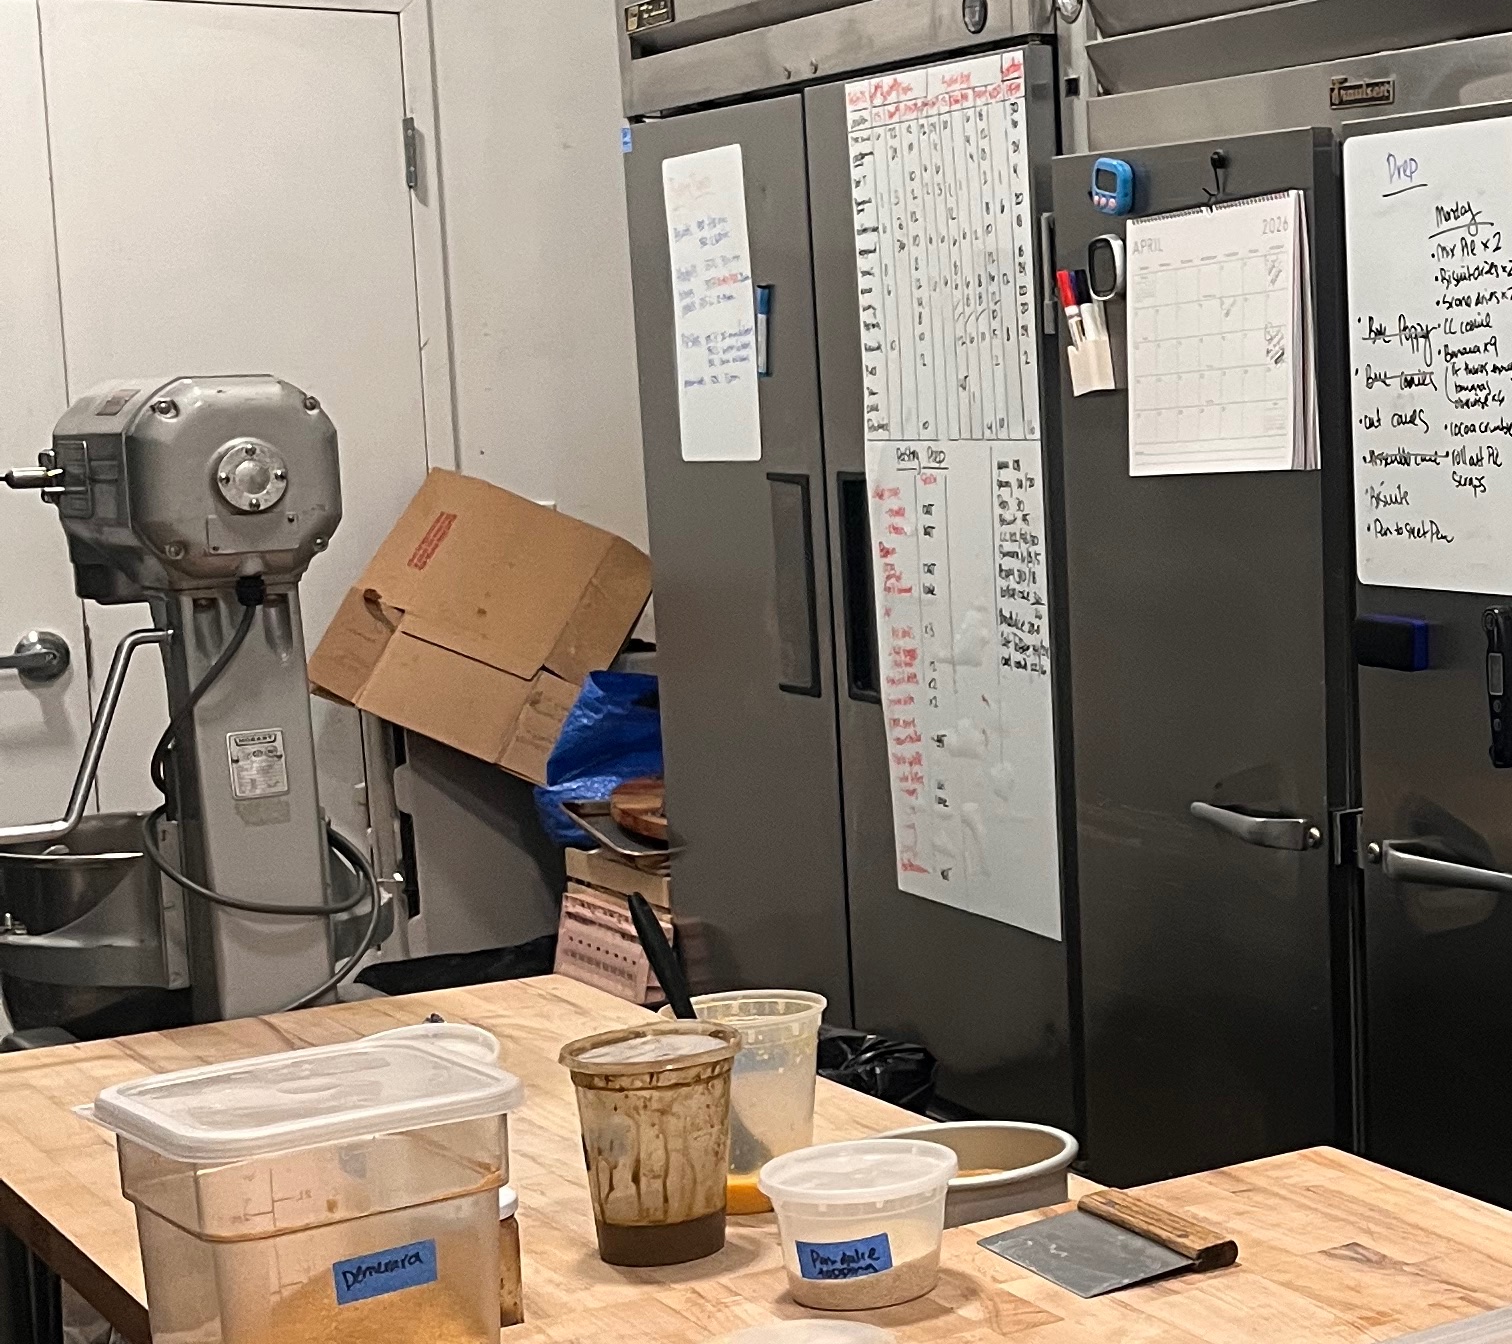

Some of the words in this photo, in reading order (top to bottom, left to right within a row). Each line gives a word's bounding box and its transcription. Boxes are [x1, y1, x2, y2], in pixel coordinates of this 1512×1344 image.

[1386, 152, 1419, 183] Prep
[1262, 216, 1289, 235] 2026
[1435, 201, 1483, 237] Monday
[1132, 237, 1164, 255] APRIL
